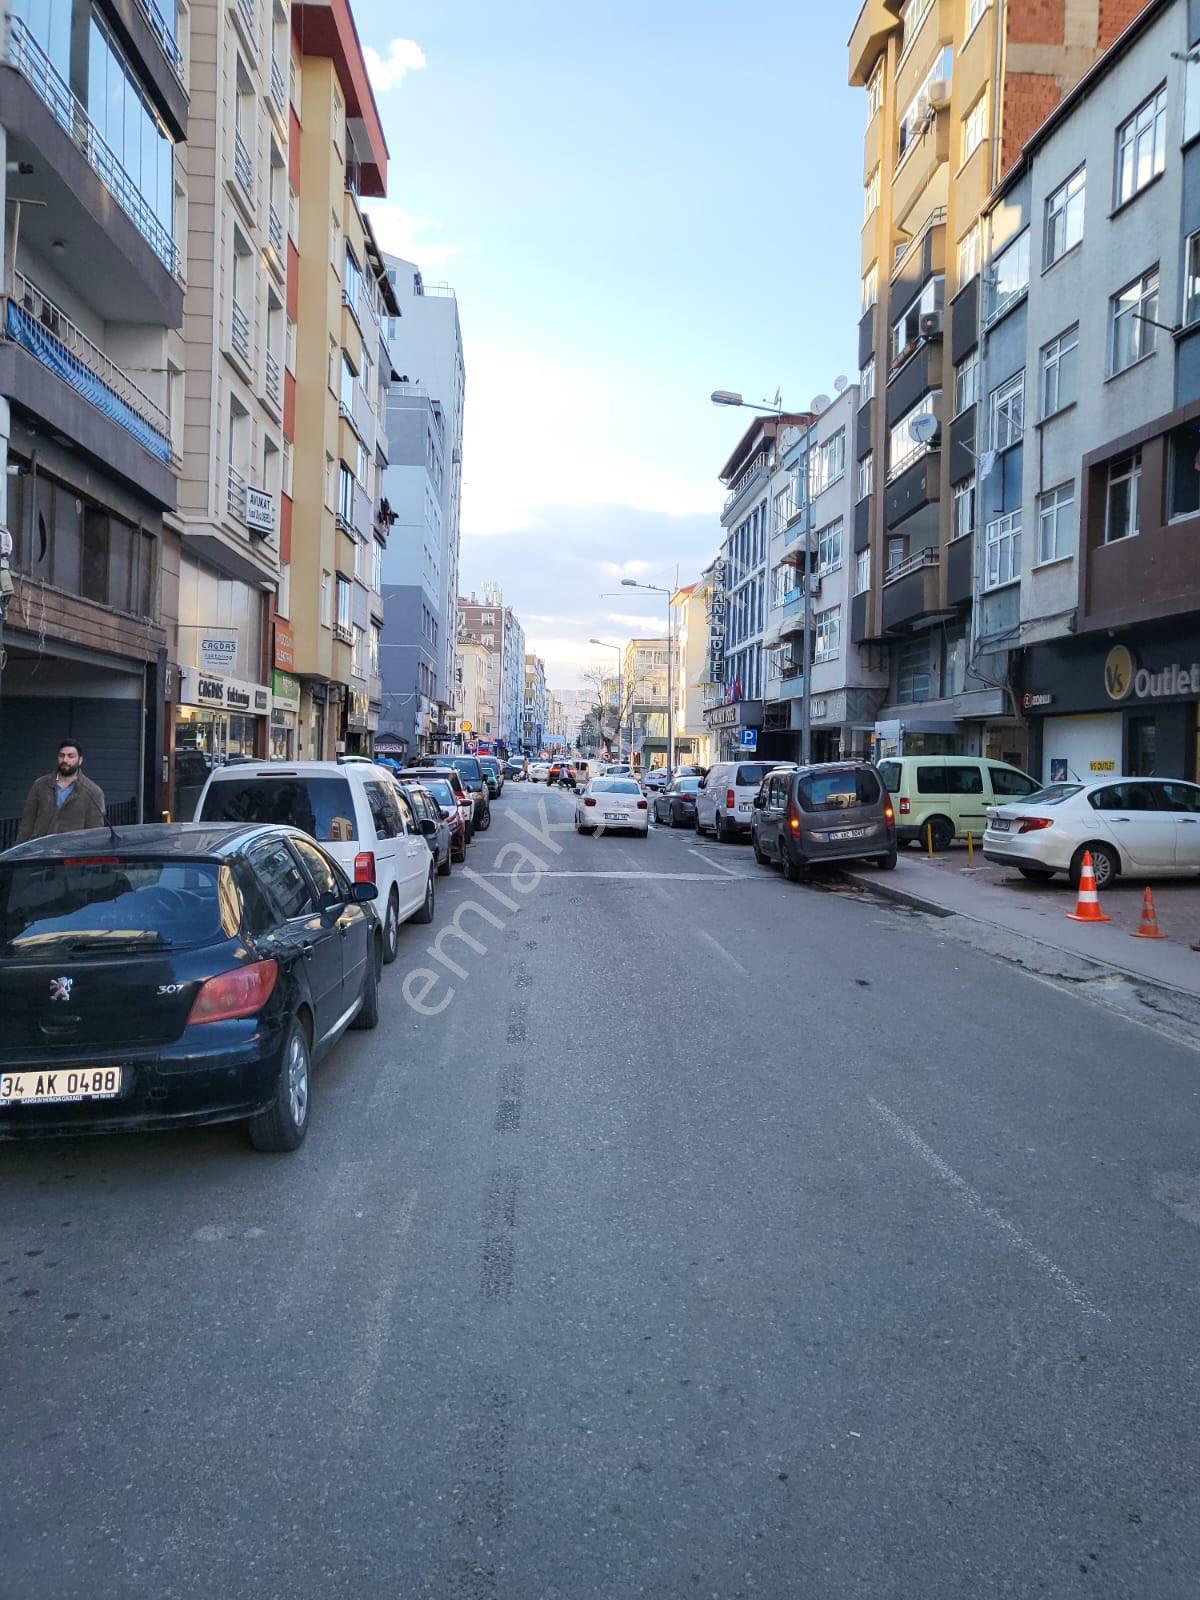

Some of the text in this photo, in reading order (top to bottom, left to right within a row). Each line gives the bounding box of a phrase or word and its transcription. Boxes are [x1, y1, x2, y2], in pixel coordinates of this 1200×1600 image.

[249, 494, 270, 511] AVUKAT
[711, 640, 723, 682] OTEL
[1135, 663, 1200, 698] Outlet
[744, 730, 754, 744] P
[1098, 761, 1115, 771] OUTLET
[157, 984, 184, 995] 307
[2, 1071, 115, 1097] 34 AK 0488
